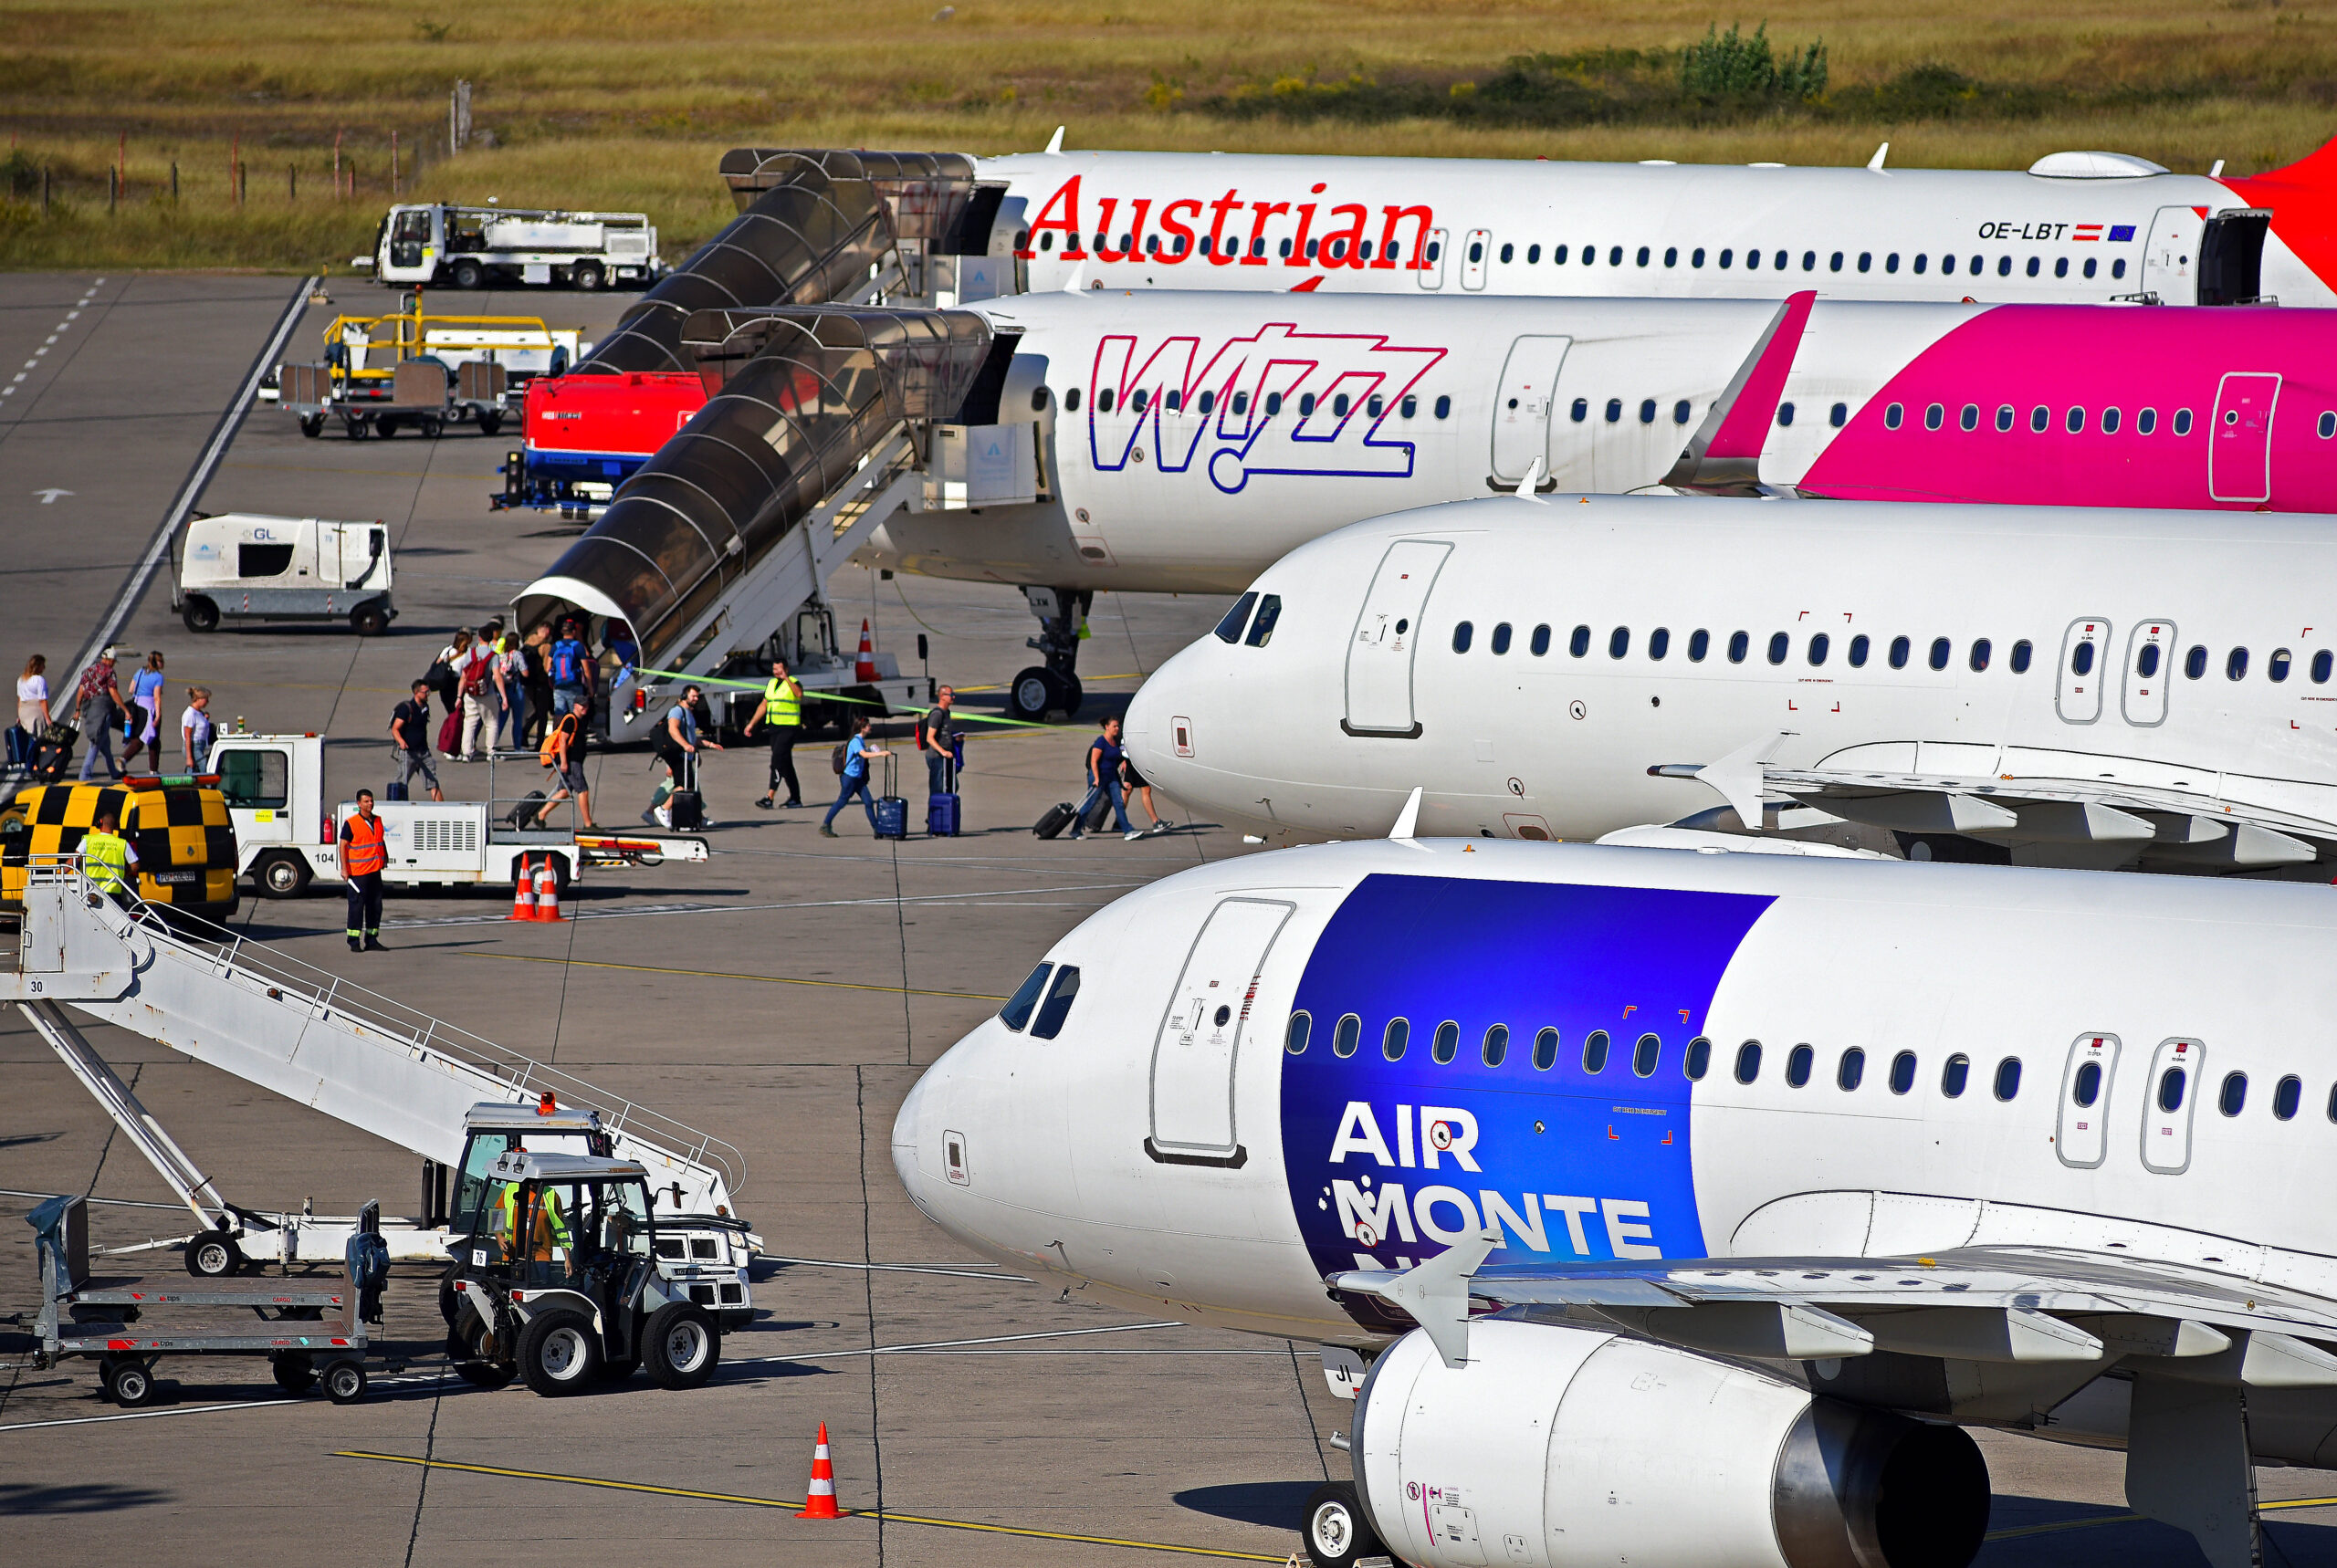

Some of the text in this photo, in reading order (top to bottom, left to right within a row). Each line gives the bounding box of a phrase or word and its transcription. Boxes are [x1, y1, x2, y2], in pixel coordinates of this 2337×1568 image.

[1011, 174, 1434, 271] Austrian
[1978, 222, 2069, 240] OE-LBT
[254, 528, 278, 539] GL
[315, 853, 334, 862] 104
[31, 981, 43, 992] 30
[1328, 1101, 1483, 1173] AIR
[1331, 1178, 1662, 1260] MONTE
[476, 1252, 484, 1263] 76
